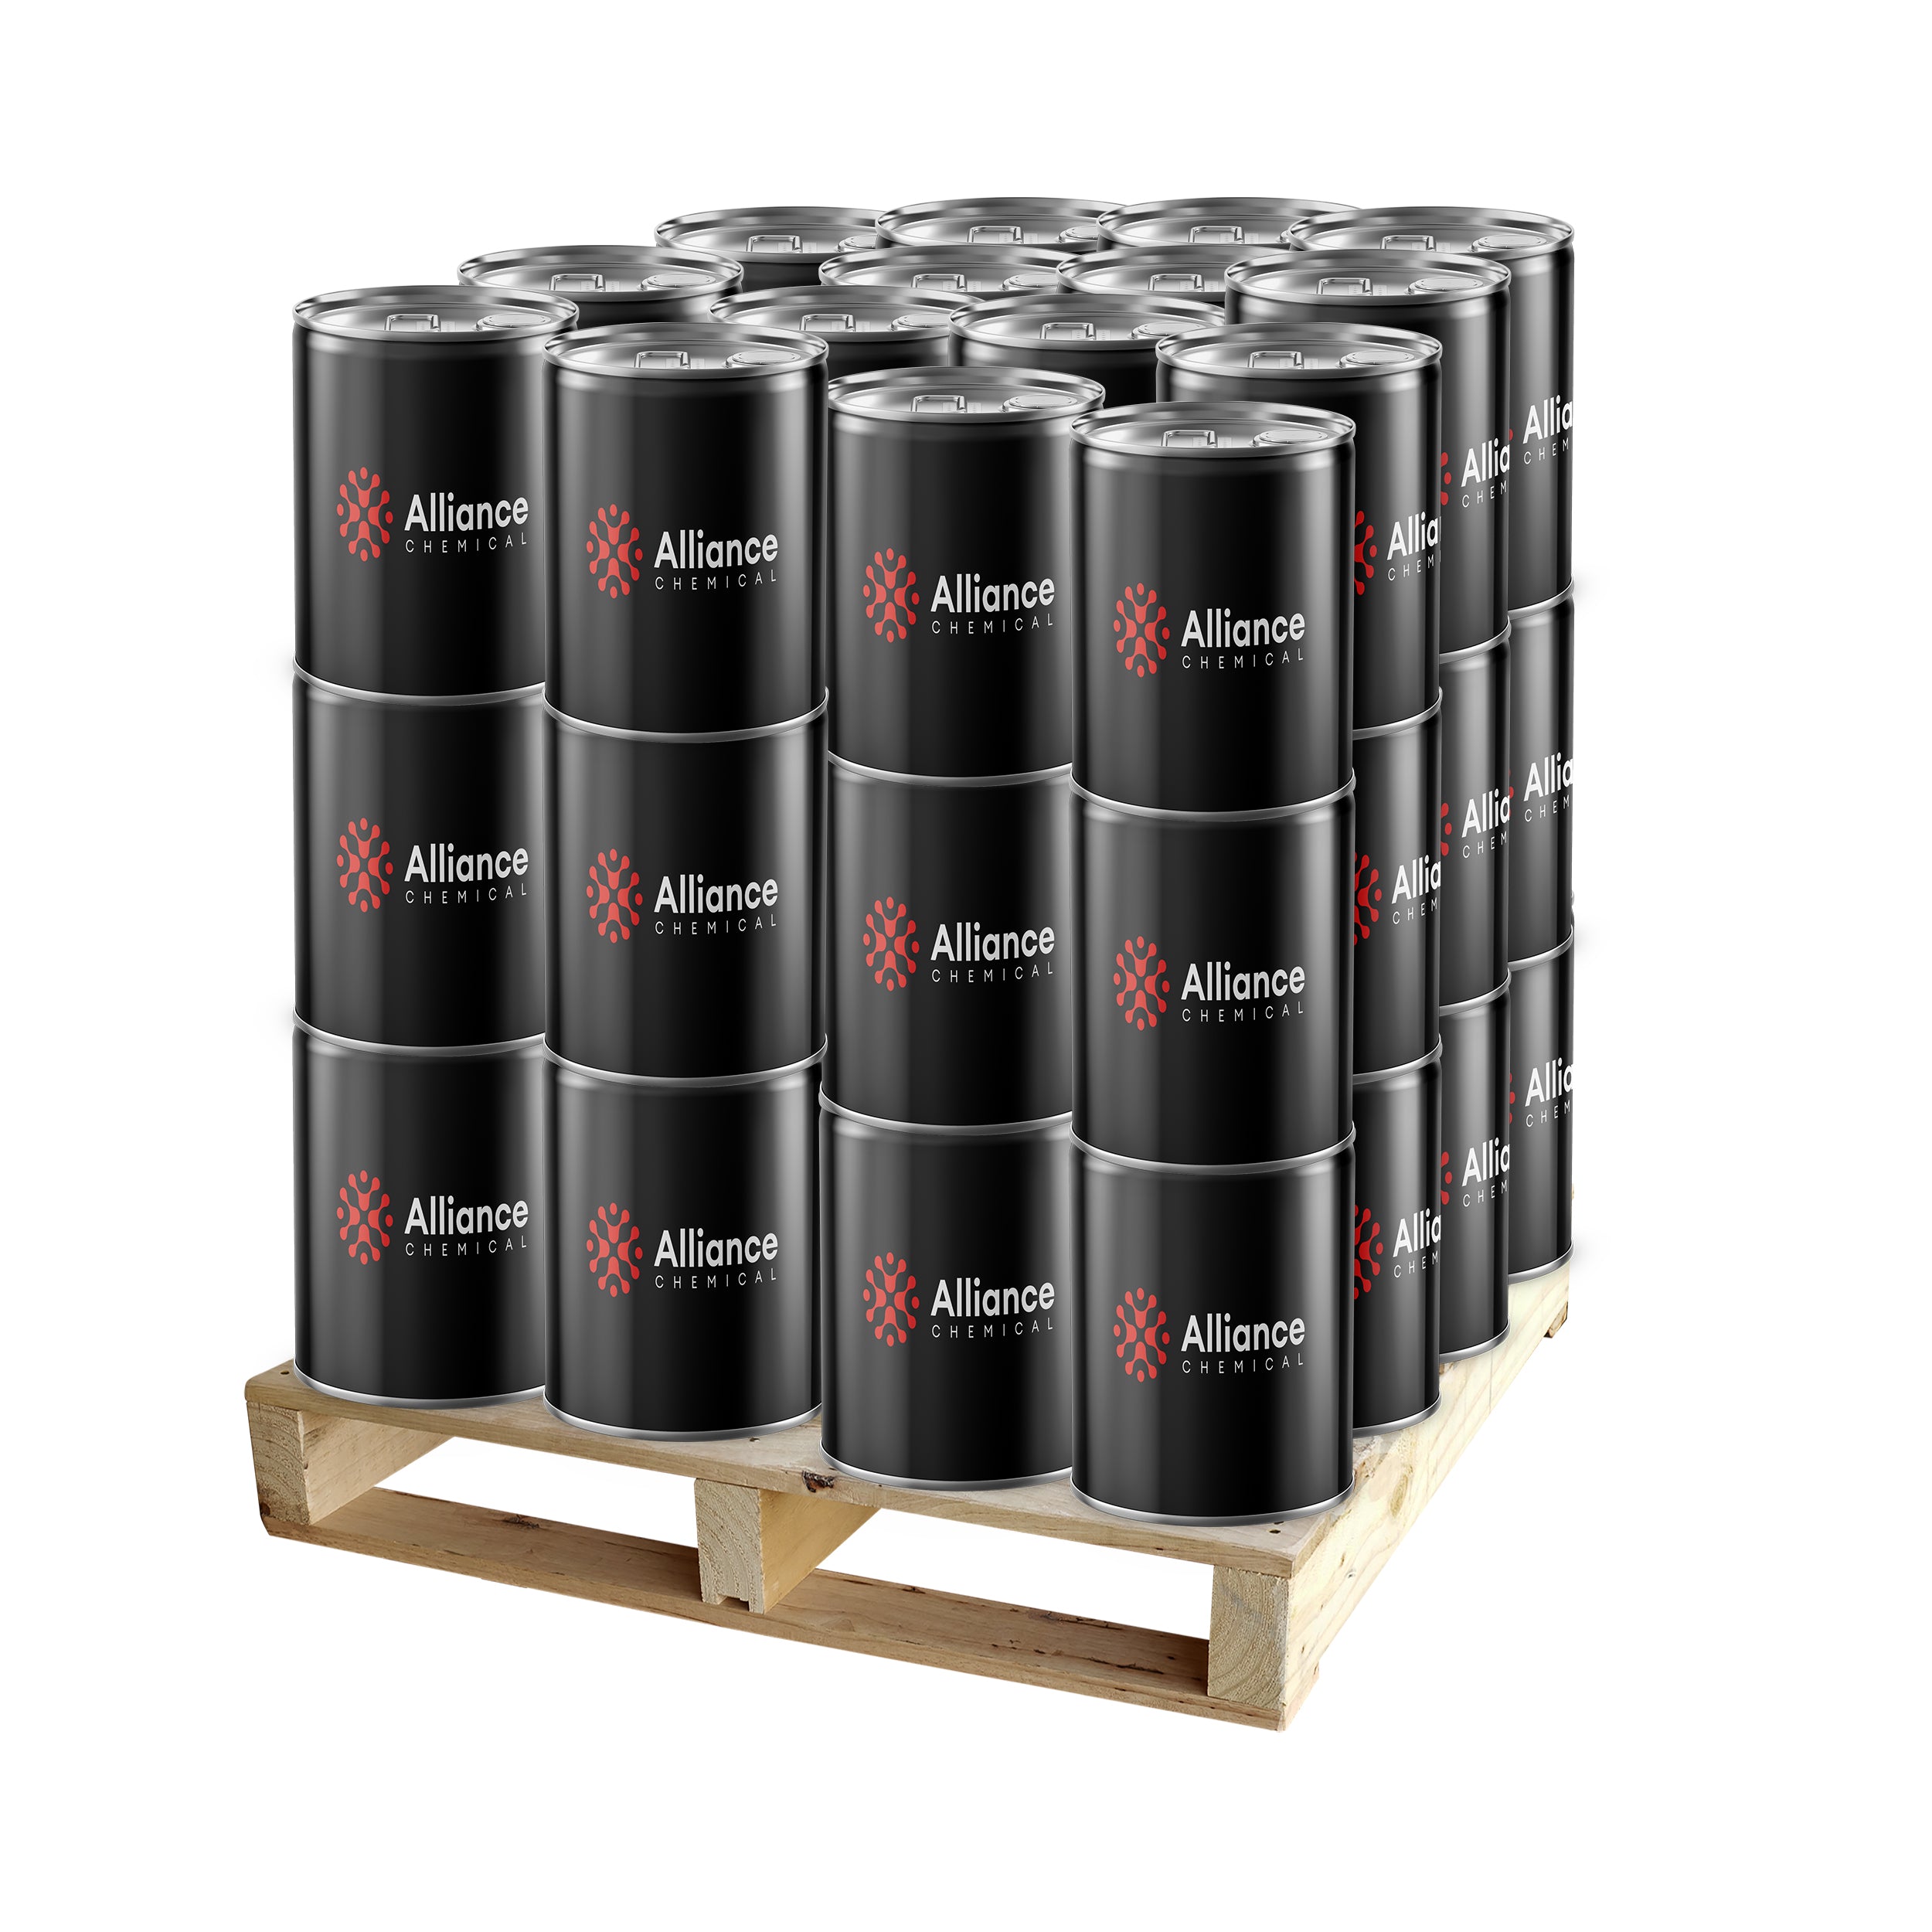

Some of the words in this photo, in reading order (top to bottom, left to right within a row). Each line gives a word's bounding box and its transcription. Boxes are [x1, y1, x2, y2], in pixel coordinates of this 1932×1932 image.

[1523, 437, 1569, 464] CHEM
[1461, 480, 1507, 508] CHEM
[403, 492, 529, 532] Alliance
[405, 532, 528, 554] CHEMICAL
[653, 529, 778, 570] Alliance
[1386, 511, 1441, 560] Allia
[655, 569, 777, 591] CHEMICAL
[930, 573, 1055, 614] Alliance
[931, 613, 1054, 635] CHEMICAL
[1180, 607, 1305, 648] Alliance
[1182, 648, 1304, 670] CHEMICAL
[1524, 794, 1570, 822] CHEM
[1462, 831, 1507, 859] CHEM
[403, 842, 529, 883] Alliance
[405, 883, 528, 905] CHEMICAL
[653, 873, 778, 914] Alliance
[655, 913, 777, 936] CHEMICAL
[1392, 896, 1438, 925] CHEM
[930, 921, 1055, 962] Alliance
[931, 961, 1054, 984] CHEMICAL
[1180, 961, 1305, 1002] Alliance
[1182, 1001, 1304, 1023] CHEMICAL
[1526, 1100, 1570, 1128] CHEM
[1462, 1179, 1508, 1207] CHEM
[403, 1195, 529, 1236] Alliance
[405, 1235, 528, 1257] CHEMICAL
[653, 1227, 778, 1268] Alliance
[1393, 1250, 1438, 1278] CHEM
[655, 1267, 777, 1290] CHEMICAL
[930, 1277, 1055, 1318] Alliance
[931, 1317, 1054, 1339] CHEMICAL
[1180, 1312, 1305, 1353] Alliance
[1182, 1352, 1304, 1375] CHEMICAL
